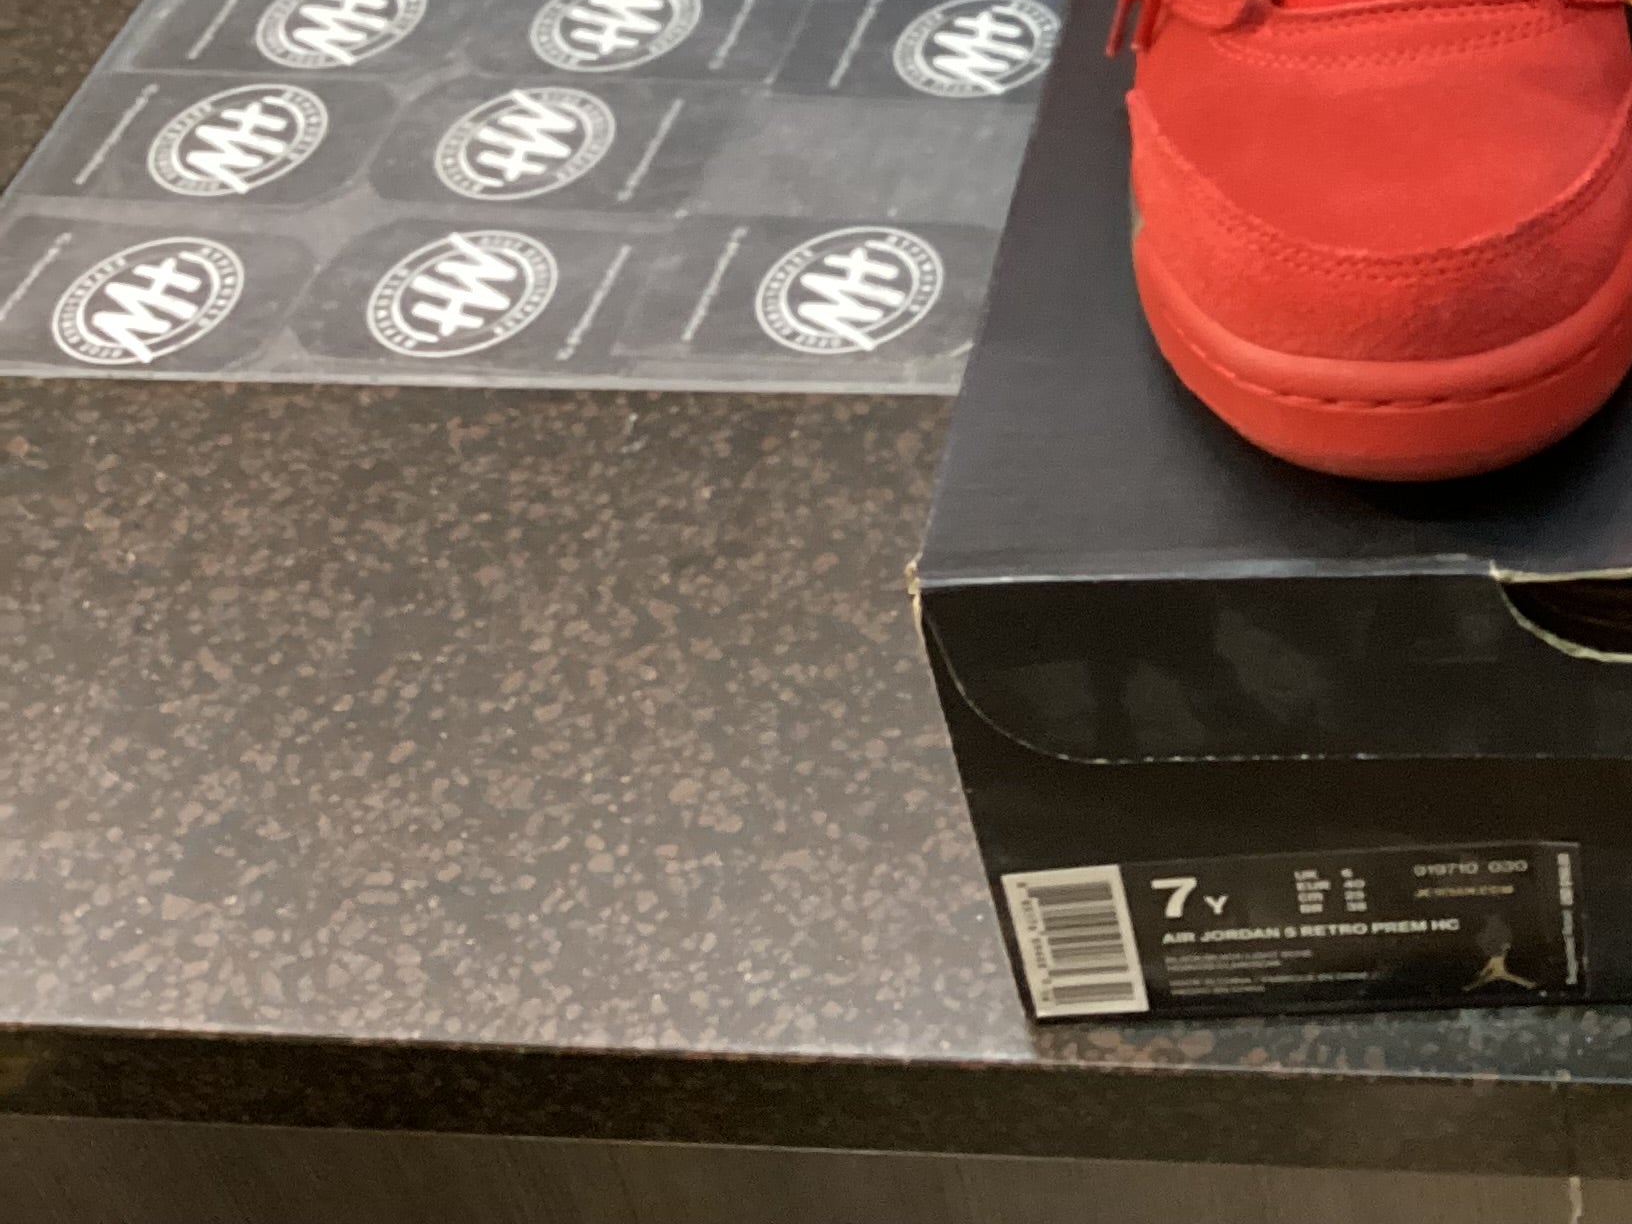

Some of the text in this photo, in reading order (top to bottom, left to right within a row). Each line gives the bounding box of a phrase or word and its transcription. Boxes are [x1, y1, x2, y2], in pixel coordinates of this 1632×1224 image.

[1151, 877, 1229, 918] 7 Y
[1162, 931, 1196, 945] AIR
[1200, 927, 1280, 943] JORDAN
[1300, 923, 1367, 937] RETRO
[1371, 920, 1427, 934] PREM
